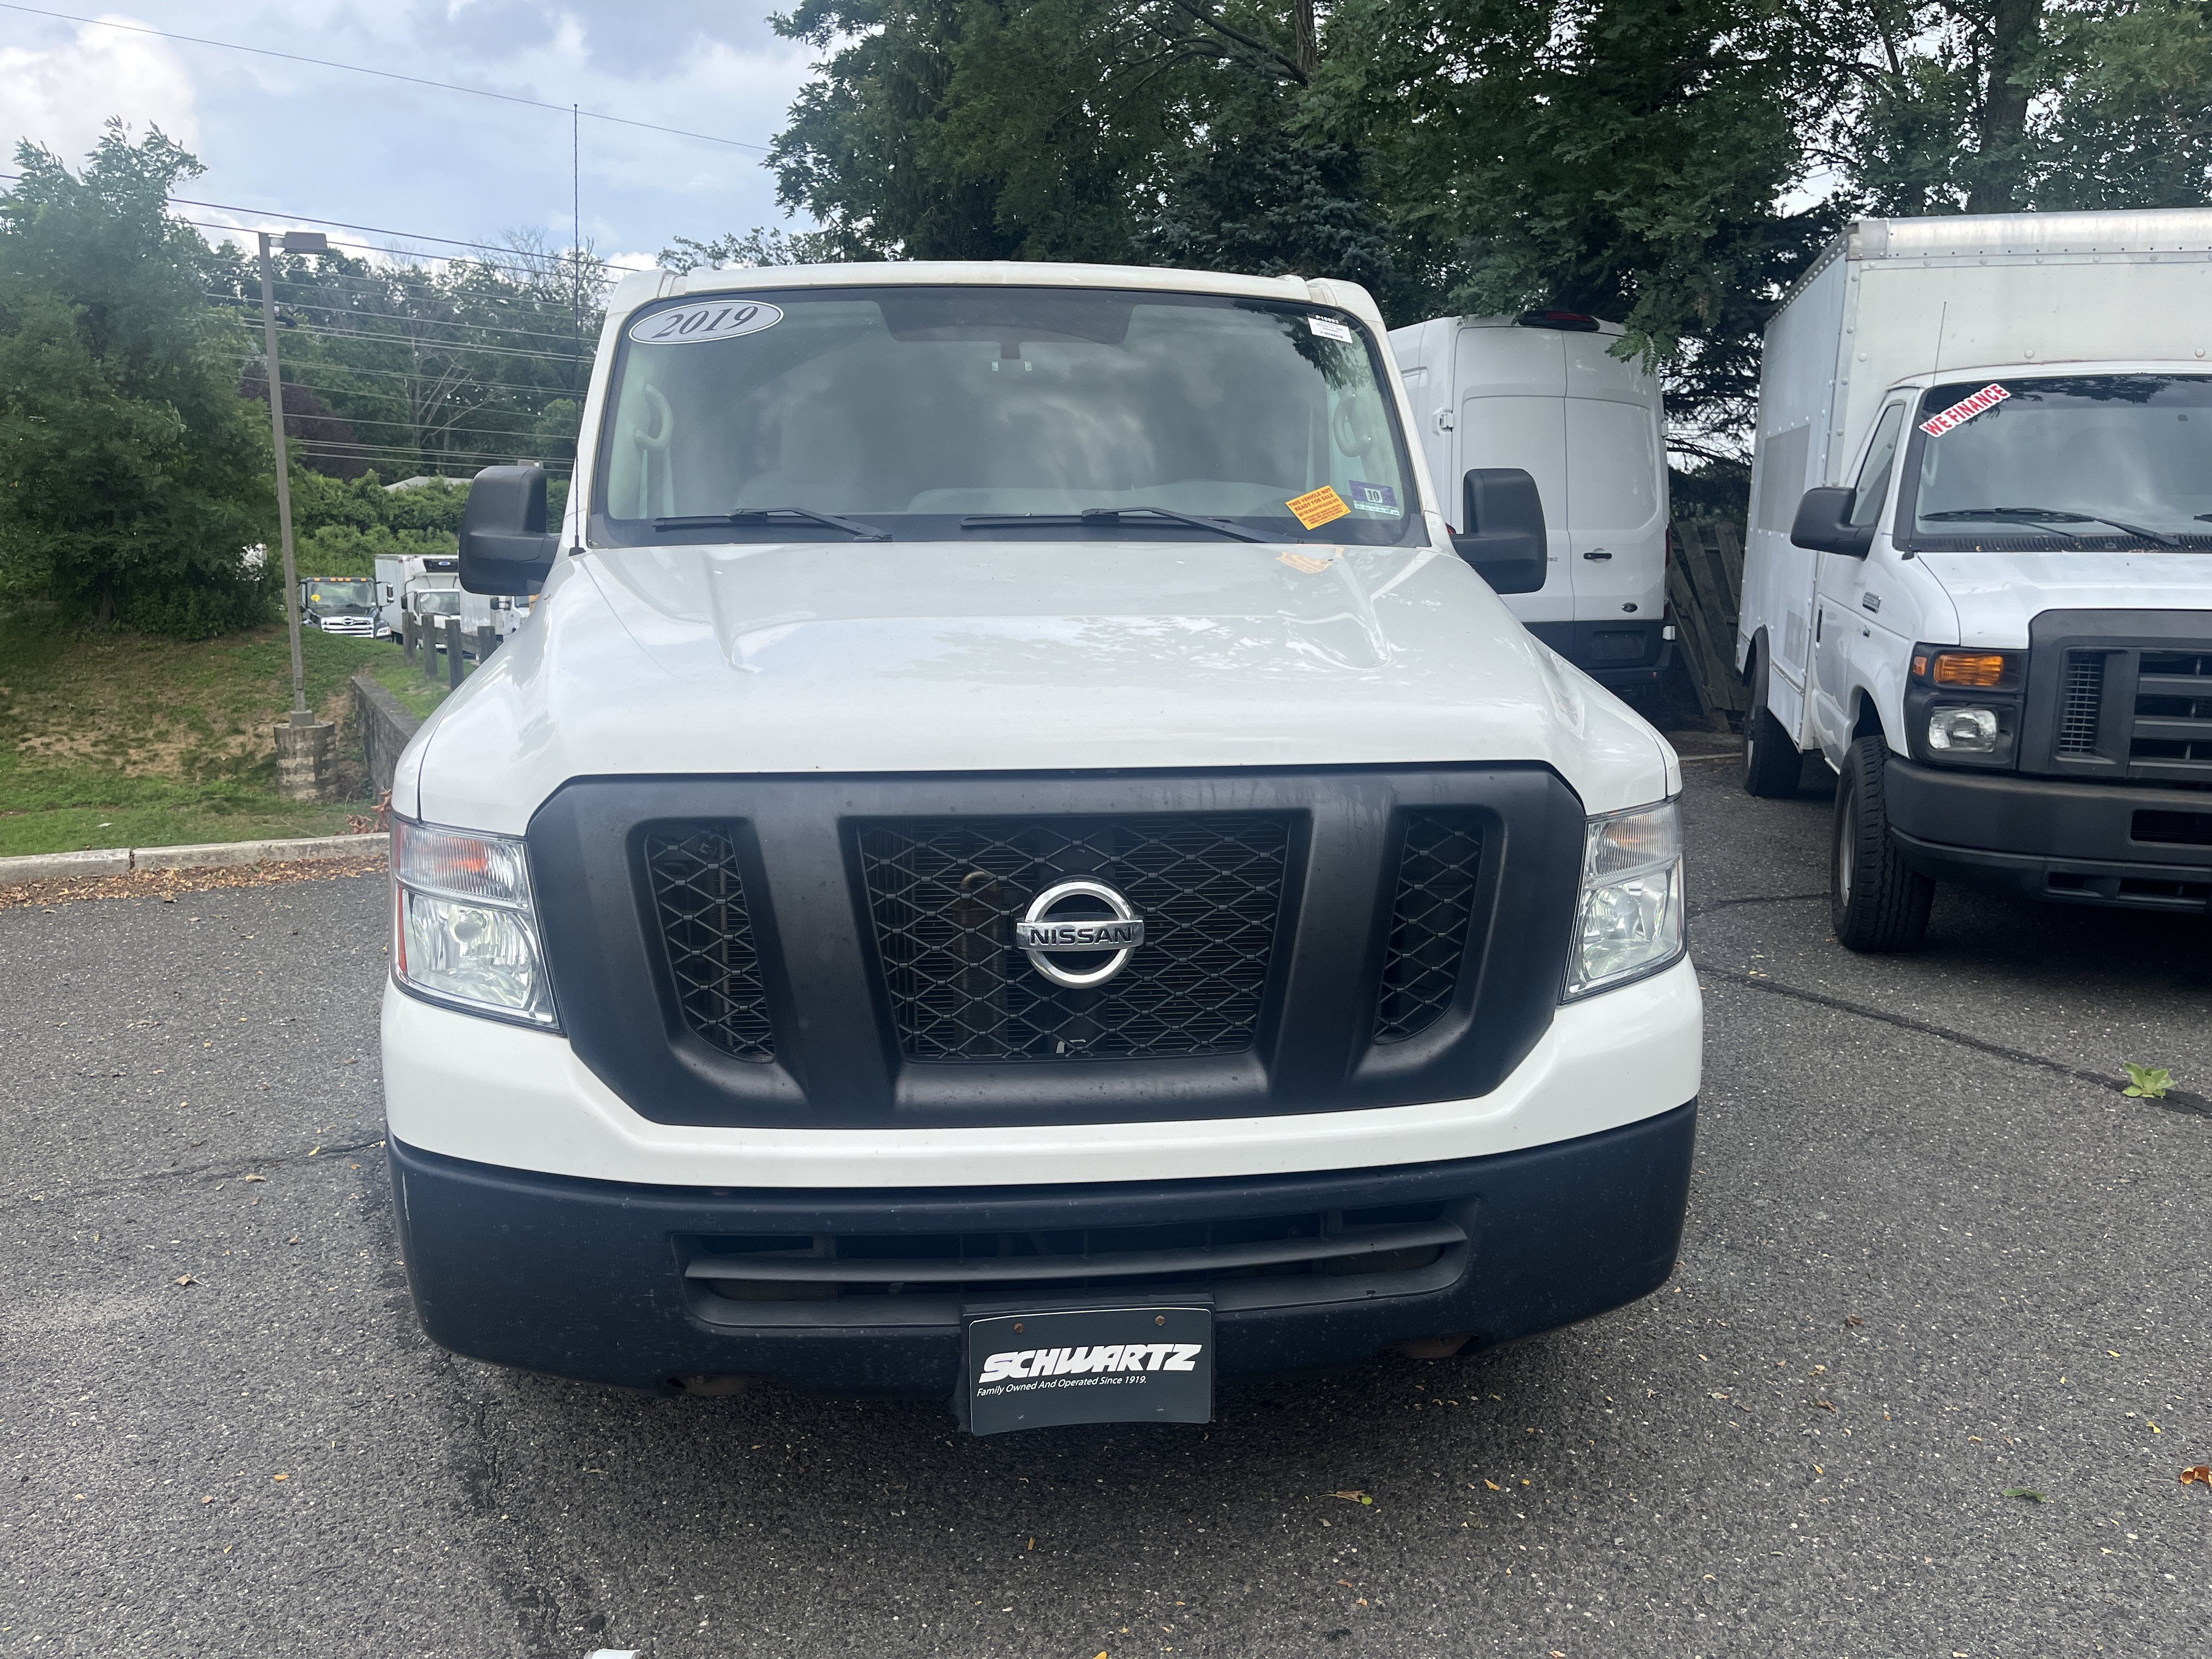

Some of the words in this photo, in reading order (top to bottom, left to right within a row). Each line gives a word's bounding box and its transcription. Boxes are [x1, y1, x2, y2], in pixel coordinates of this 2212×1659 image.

[650, 306, 759, 338] 2019
[1922, 416, 1952, 436] WE
[1945, 385, 2007, 423] FINANCE
[1300, 492, 1321, 503] VEHICLE
[1367, 490, 1380, 501] 10
[1294, 503, 1311, 511] READY
[1030, 927, 1132, 945] NISSAN
[978, 1344, 1202, 1384] SCHWARTZ
[977, 1385, 1005, 1397] Family
[1006, 1381, 1037, 1393] Owned
[1038, 1379, 1056, 1389] And
[1058, 1376, 1099, 1389] Operated
[1099, 1375, 1122, 1385] Since
[1124, 1375, 1147, 1385] 1919.
